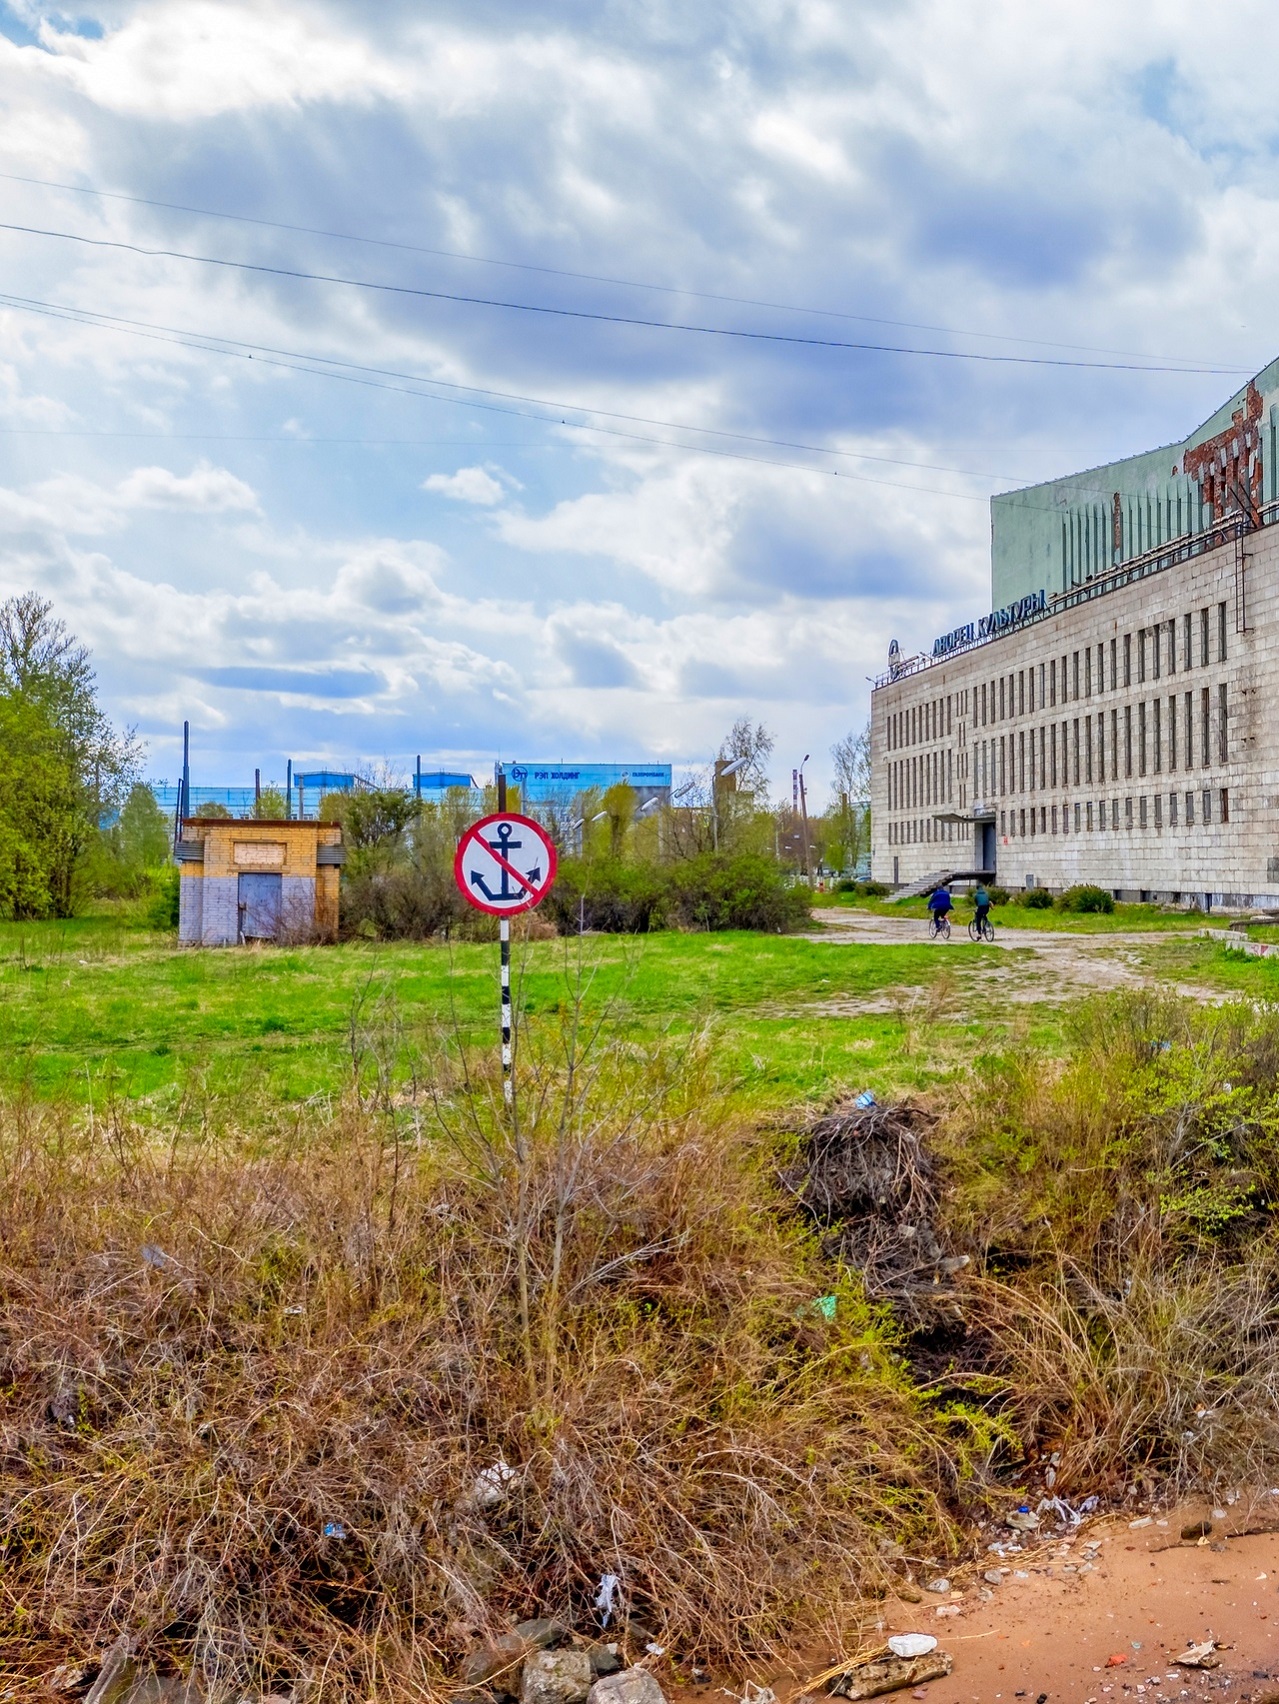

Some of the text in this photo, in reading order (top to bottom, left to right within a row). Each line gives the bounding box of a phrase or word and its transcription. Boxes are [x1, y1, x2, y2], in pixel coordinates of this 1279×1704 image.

[932, 590, 1045, 656] ДВОРЕЦ КУЛЬТУРЫ
[534, 771, 549, 780] РЭП
[551, 771, 580, 781] ХОЛДИНГ
